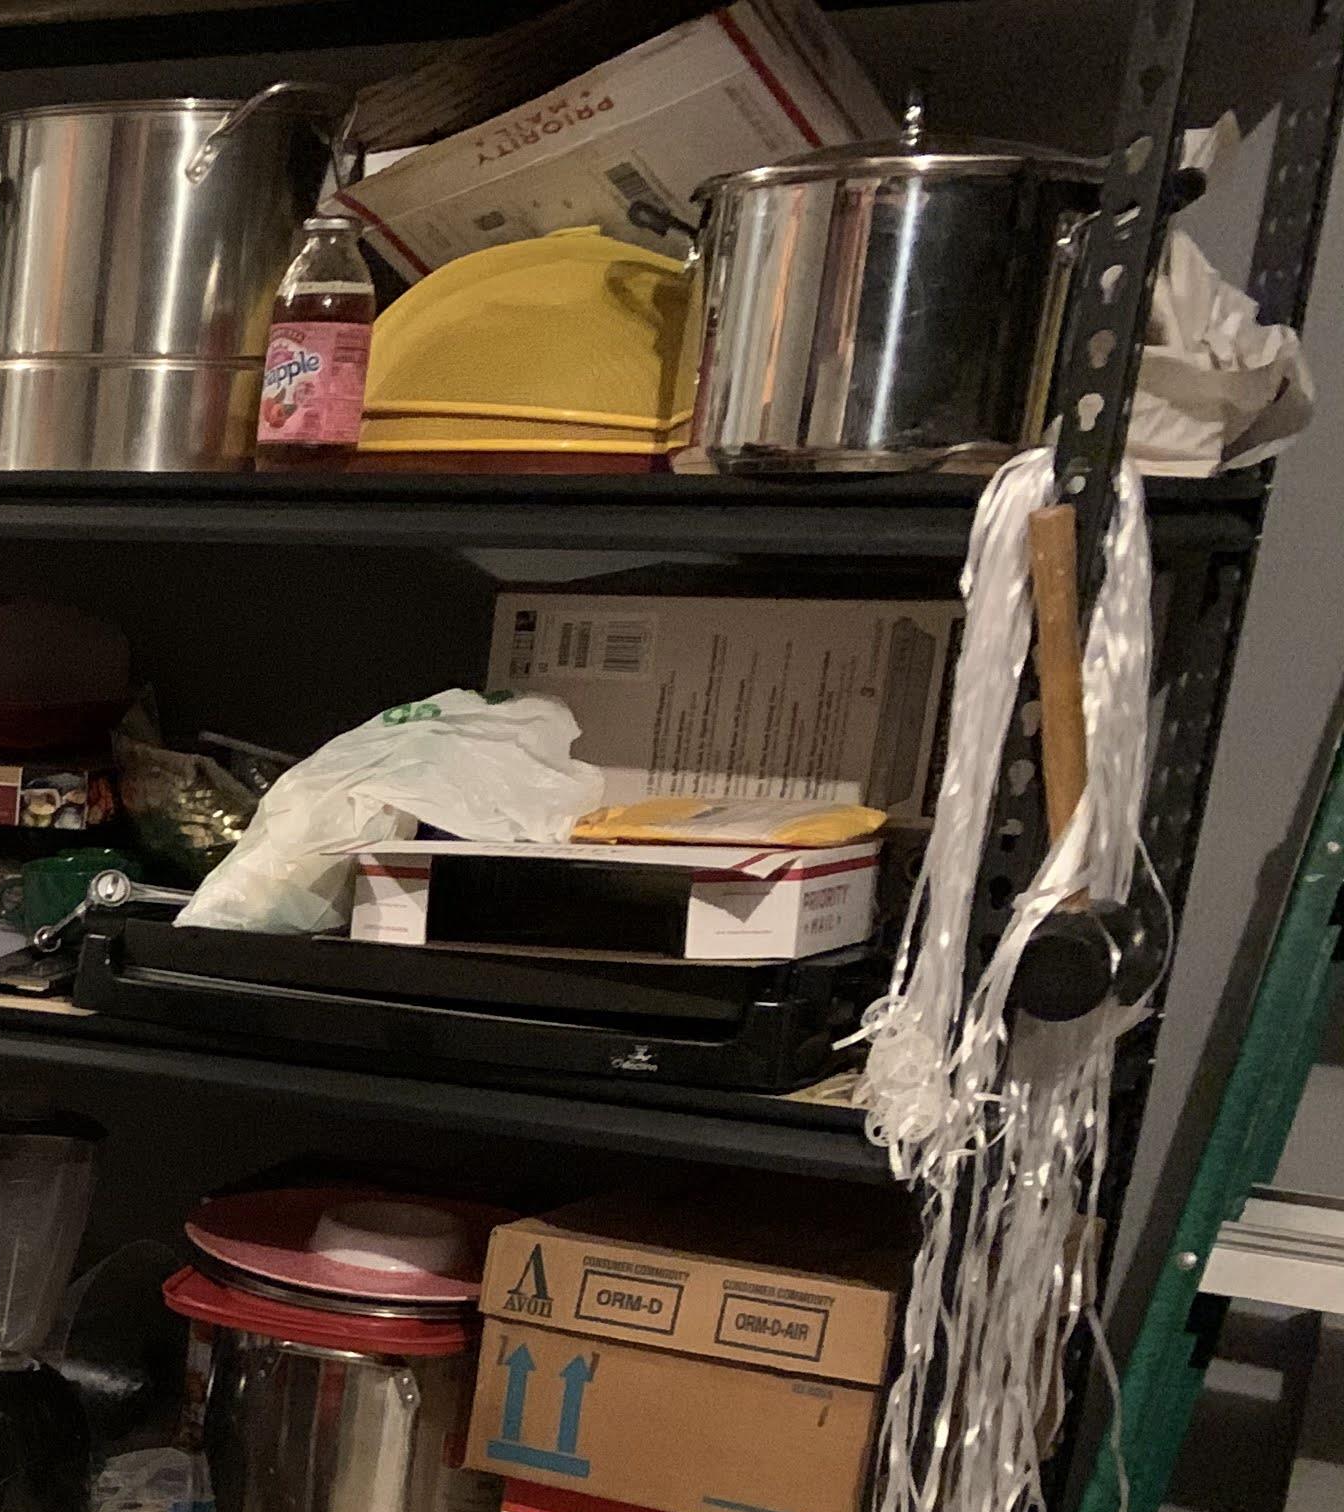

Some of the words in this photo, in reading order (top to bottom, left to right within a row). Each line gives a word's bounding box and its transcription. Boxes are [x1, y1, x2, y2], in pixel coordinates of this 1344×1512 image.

[472, 97, 614, 168] PRIORITY
[583, 1255, 634, 1274] CONSUMER
[633, 1263, 690, 1282] COMMODITY
[596, 1289, 663, 1315] ORM-D
[722, 1279, 775, 1297] CONSUMER
[776, 1286, 836, 1307] COMMODITY
[734, 1313, 810, 1341] ORM-D-AIR
